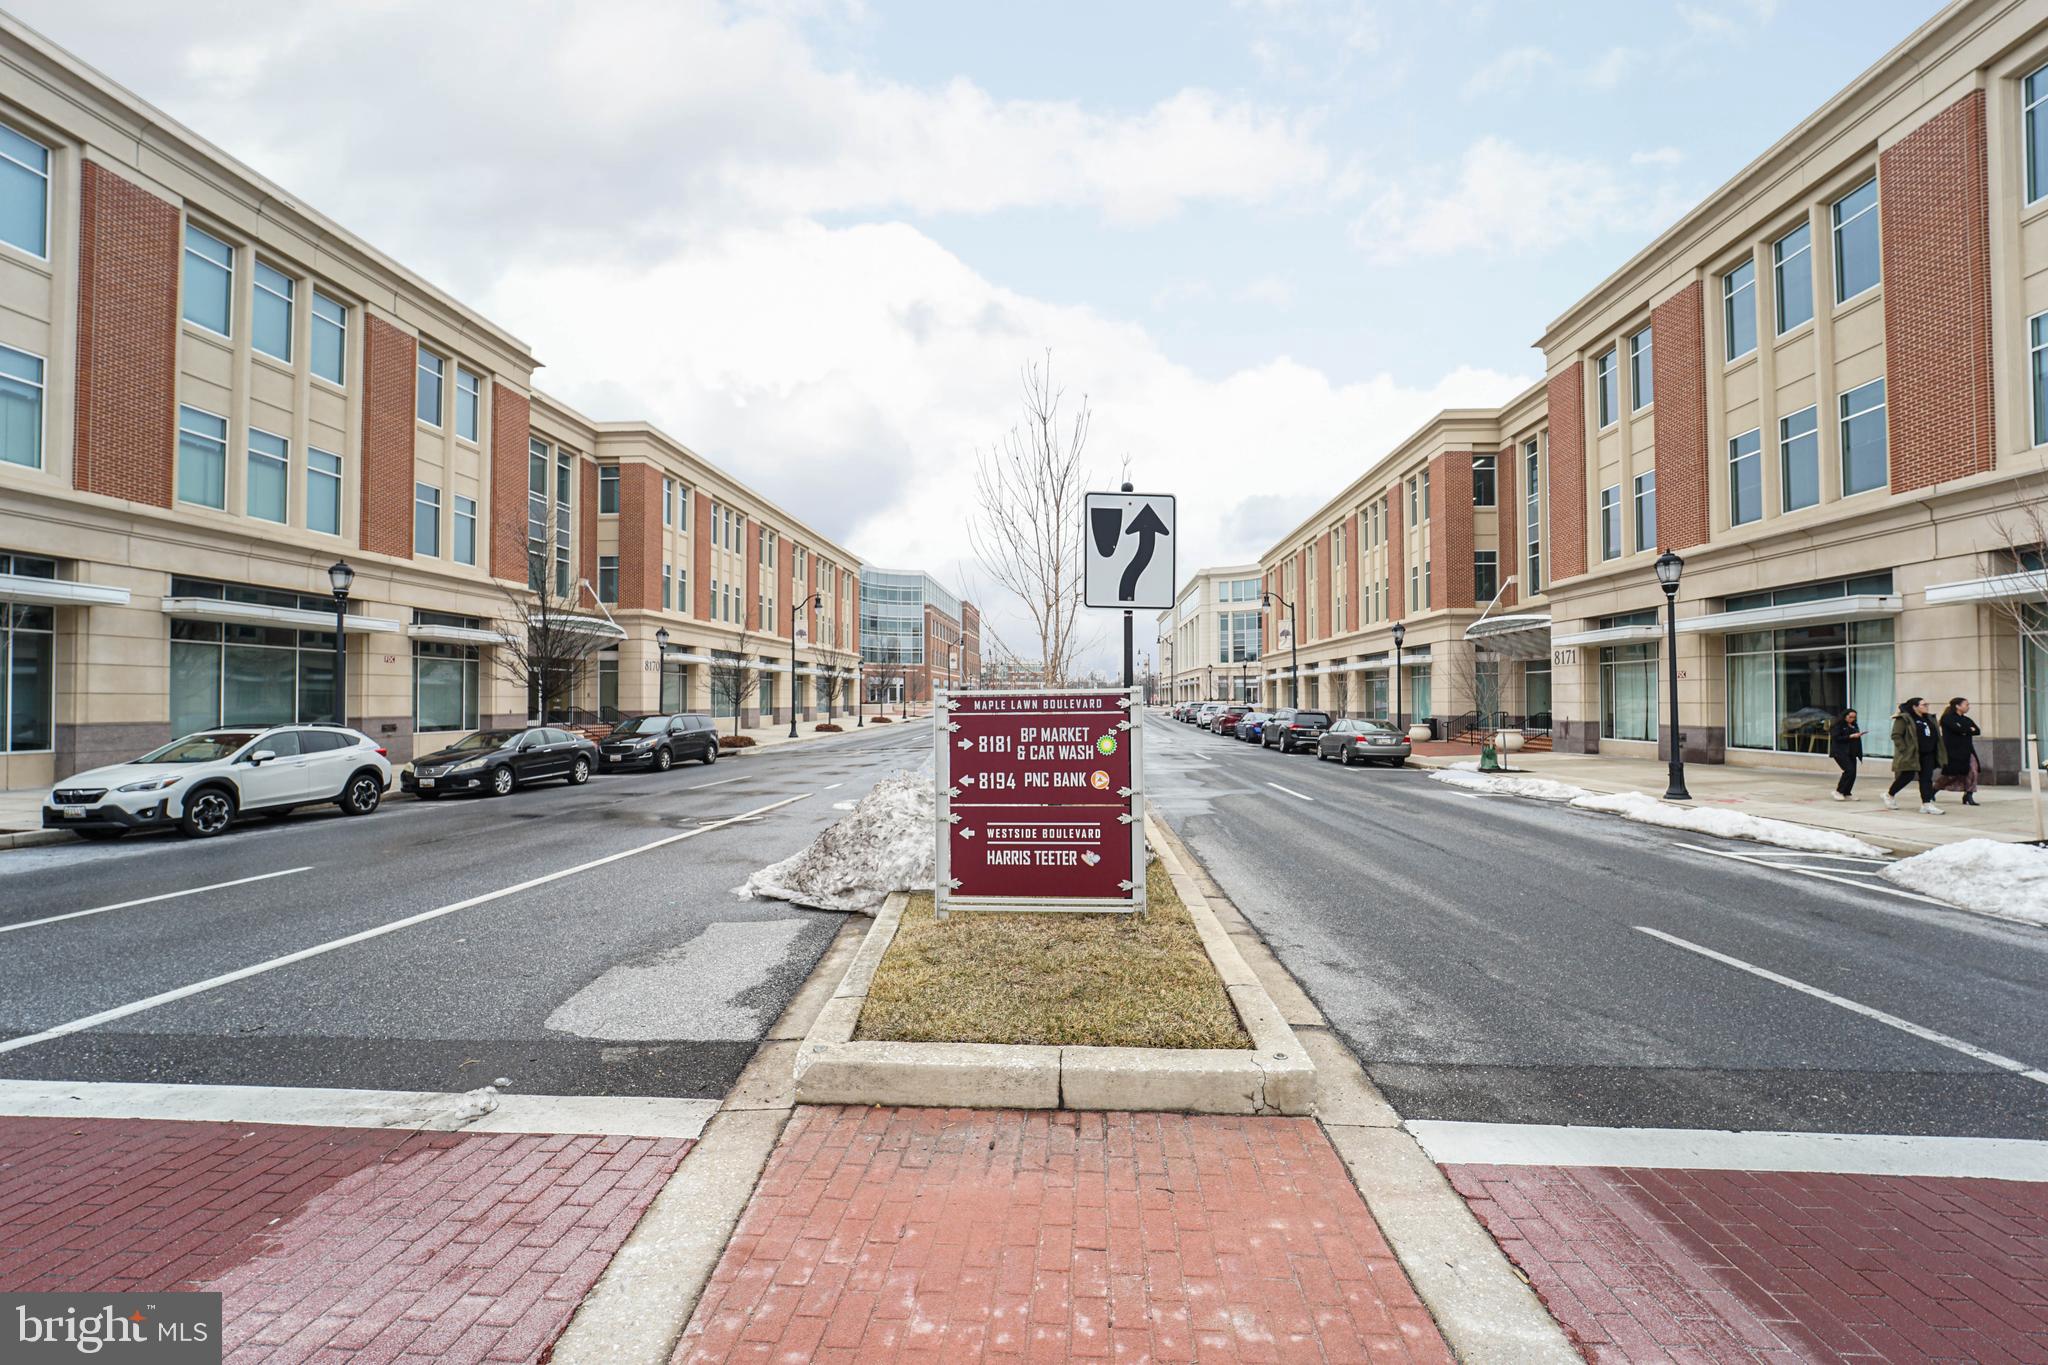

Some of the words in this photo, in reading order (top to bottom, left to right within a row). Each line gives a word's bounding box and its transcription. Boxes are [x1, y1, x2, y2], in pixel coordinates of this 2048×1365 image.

[1554, 650, 1576, 664] 8171
[645, 661, 660, 671] 8170
[974, 700, 1005, 710] MAPLE
[1011, 700, 1037, 709] LAWN
[1043, 699, 1101, 709] BOULEVARD
[1021, 728, 1036, 742] BP
[1041, 727, 1089, 742] MARKET
[1107, 728, 1117, 736] bp
[979, 736, 1010, 752] 8181
[1018, 746, 1025, 760] &
[1030, 745, 1054, 760] CAR
[1059, 745, 1093, 759] WASH
[979, 773, 1016, 789] 8194
[1025, 773, 1049, 787] PNC
[1054, 772, 1086, 787] BANK
[987, 829, 1036, 838] WESTSIDE
[1043, 829, 1100, 838] BOULEVARD
[987, 850, 1030, 865] HARRIS
[1034, 851, 1077, 865] TEETER
